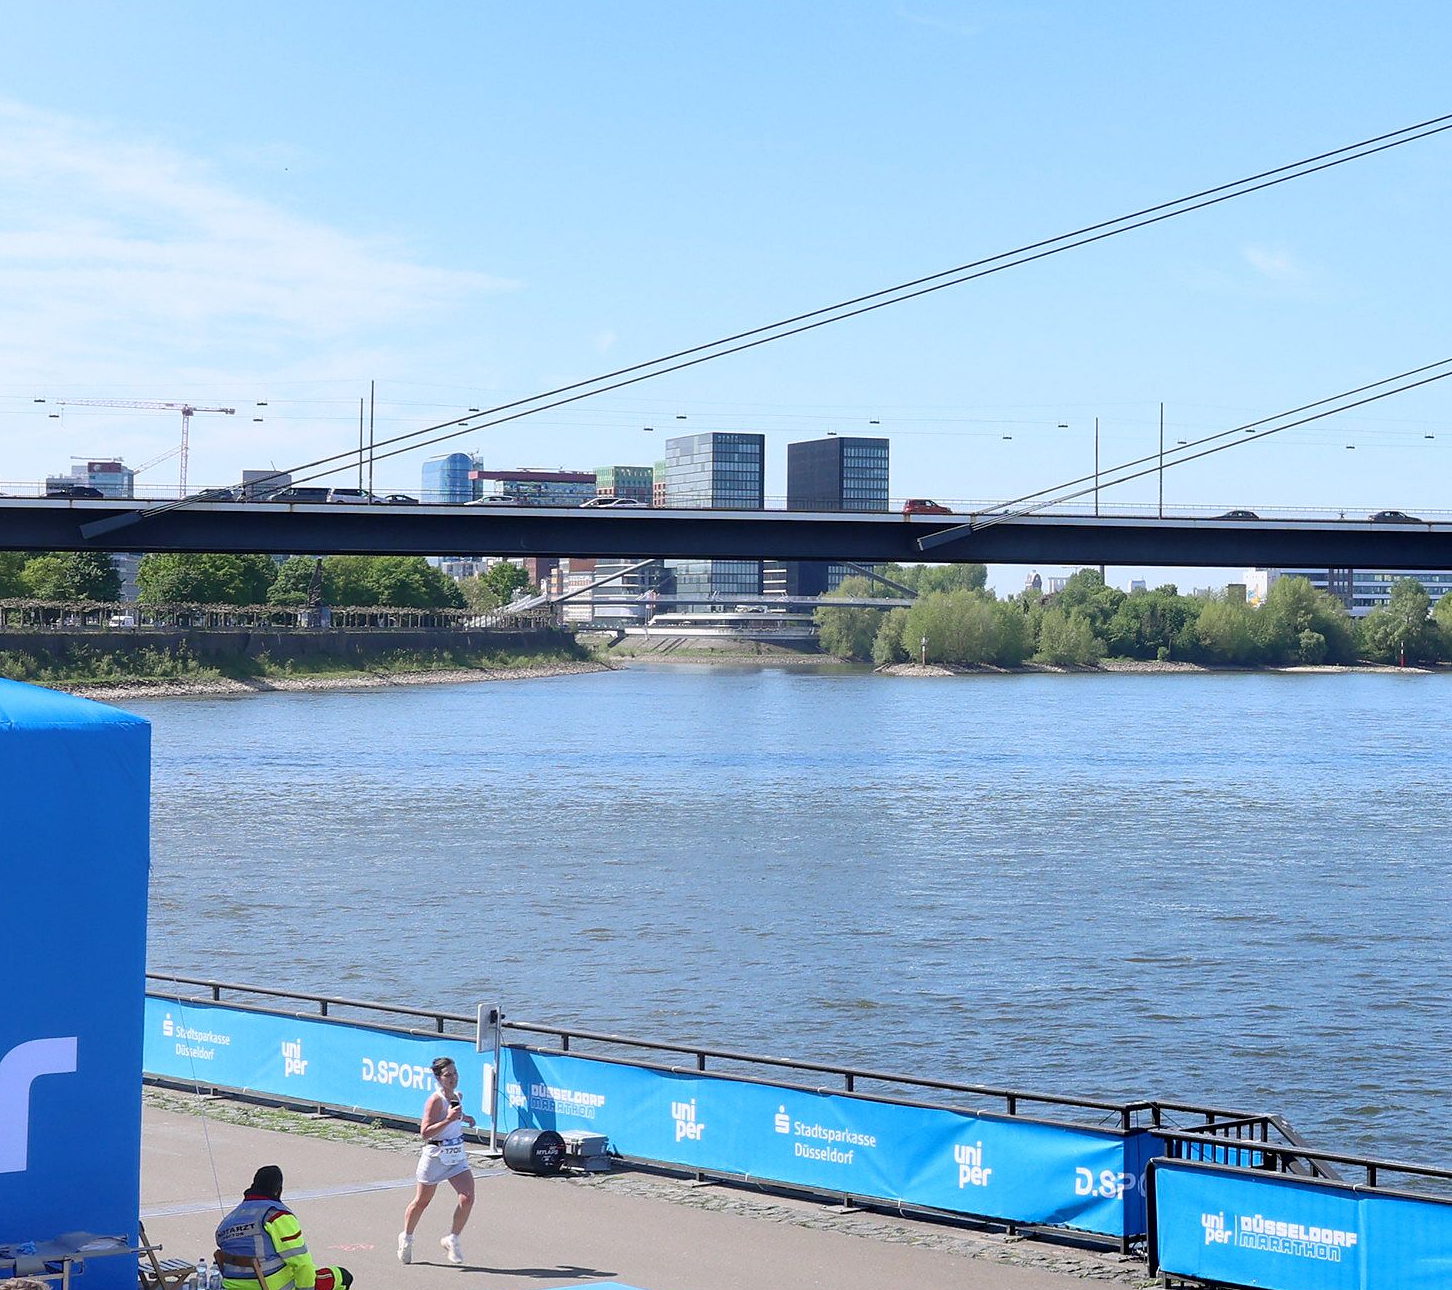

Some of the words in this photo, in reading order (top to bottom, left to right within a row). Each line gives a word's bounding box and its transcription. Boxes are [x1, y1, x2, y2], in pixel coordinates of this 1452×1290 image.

[176, 1026, 230, 1047] Stadtsparkasse
[176, 1042, 217, 1059] Düsseldorf
[282, 1039, 300, 1060] uni
[285, 1058, 307, 1077] per
[672, 1099, 695, 1125] uni
[675, 1118, 705, 1141] per
[794, 1121, 876, 1150] Stadtsparkasse
[795, 1141, 857, 1164] Düsseldorf
[954, 1141, 982, 1168] uni
[959, 1163, 992, 1188] per
[1202, 1212, 1224, 1231] uni
[1240, 1214, 1357, 1250] DÜSSELDORF
[1204, 1226, 1232, 1245] per
[1240, 1231, 1343, 1261] MARATHON
